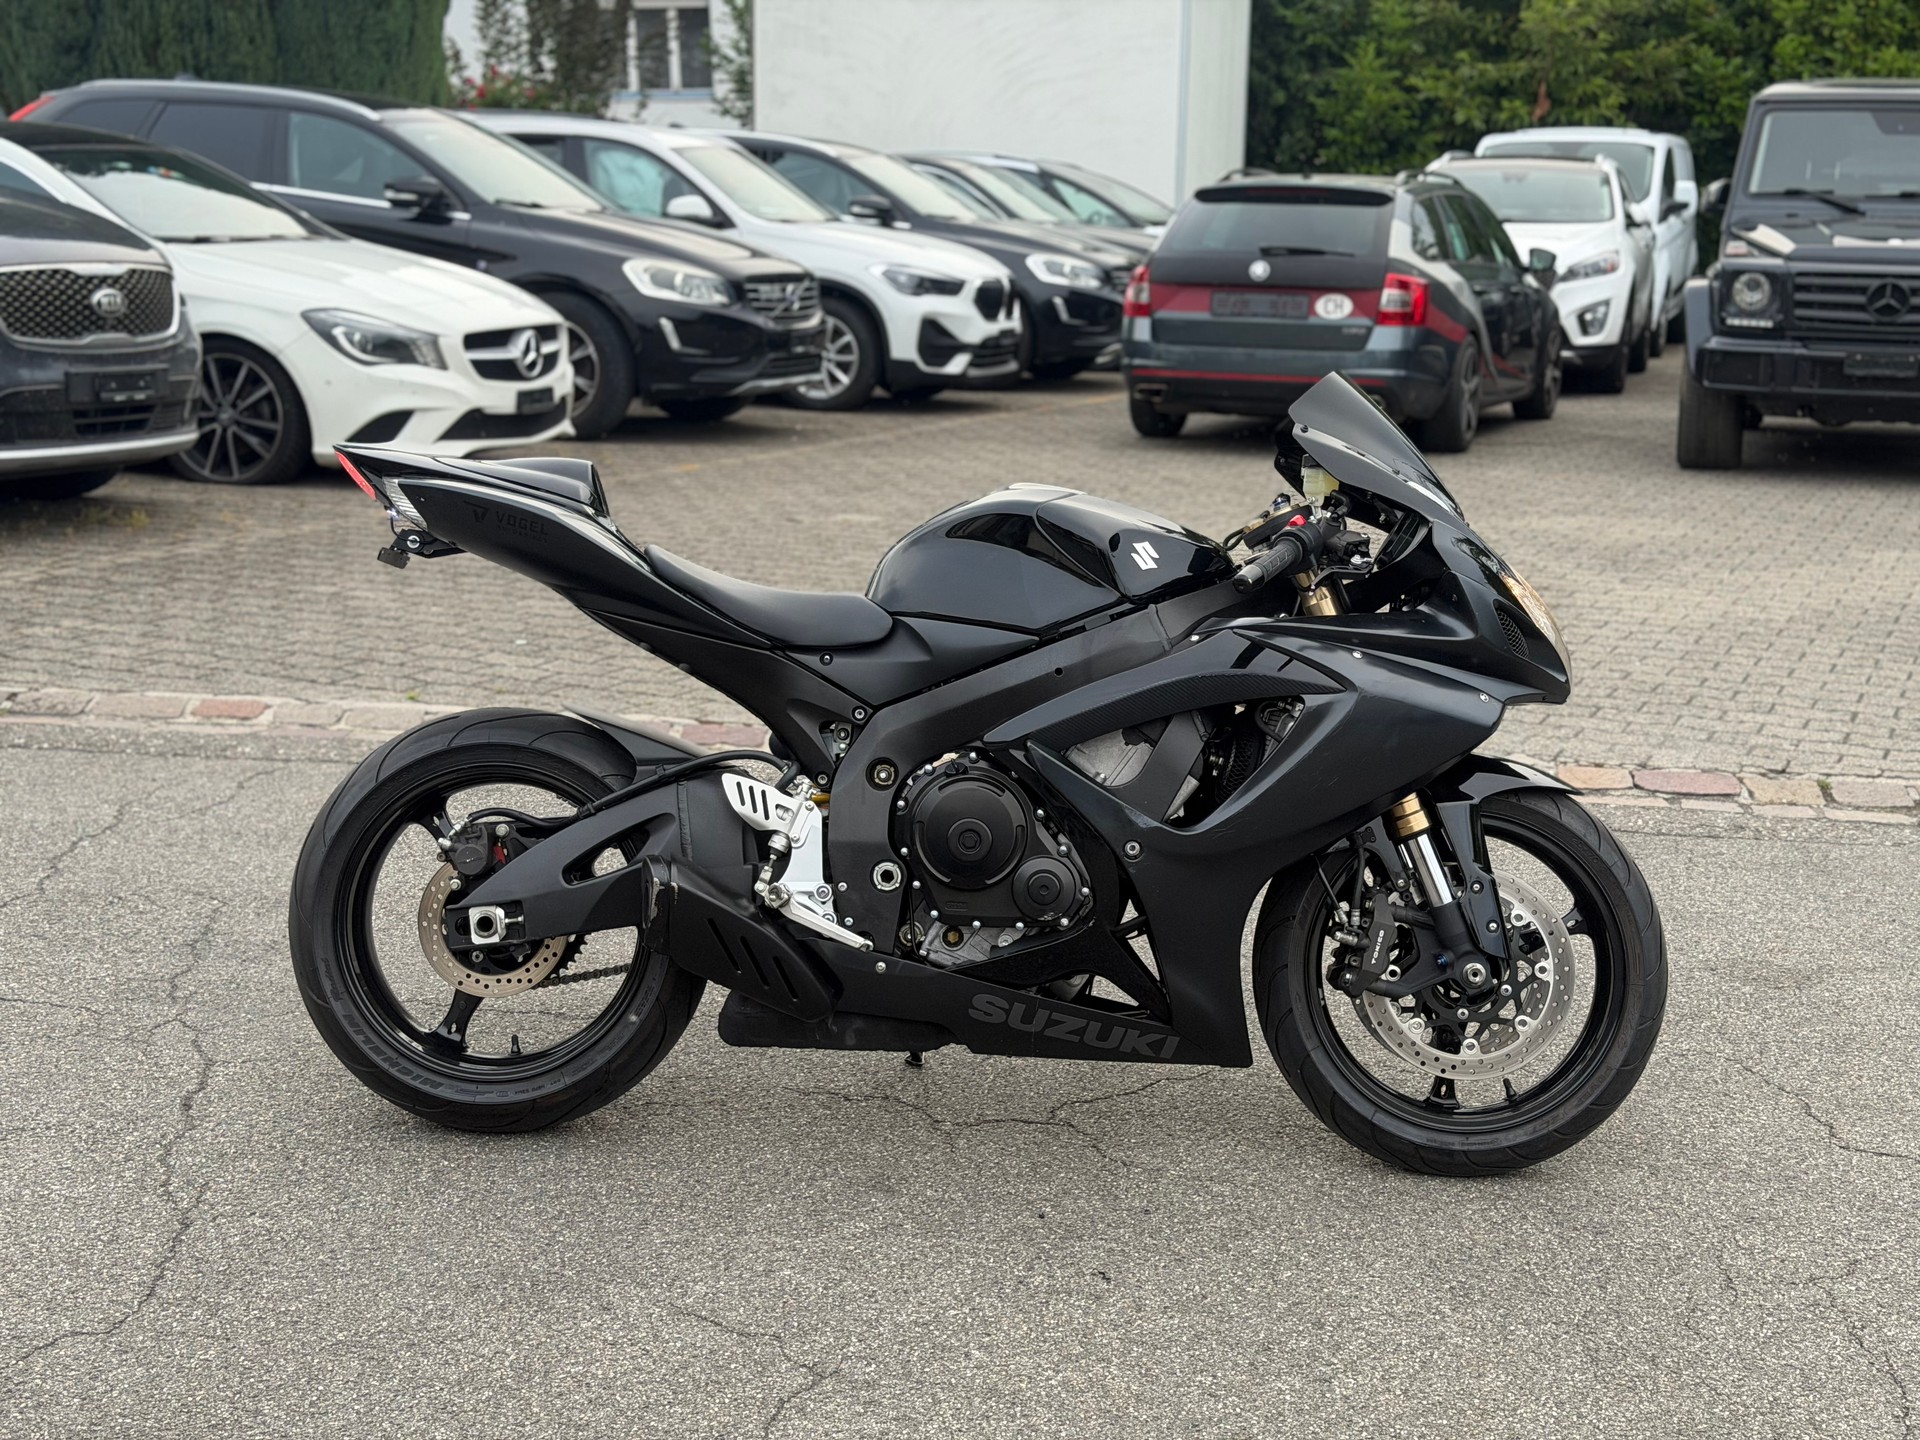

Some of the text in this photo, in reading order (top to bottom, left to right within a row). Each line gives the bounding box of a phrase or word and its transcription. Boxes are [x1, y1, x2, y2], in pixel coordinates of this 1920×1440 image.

[1323, 297, 1345, 315] CH
[496, 510, 548, 536] VOGEL
[1371, 930, 1384, 964] TOKICO
[968, 993, 1180, 1059] SUZUKI
[342, 1014, 445, 1090] MICHELIN
